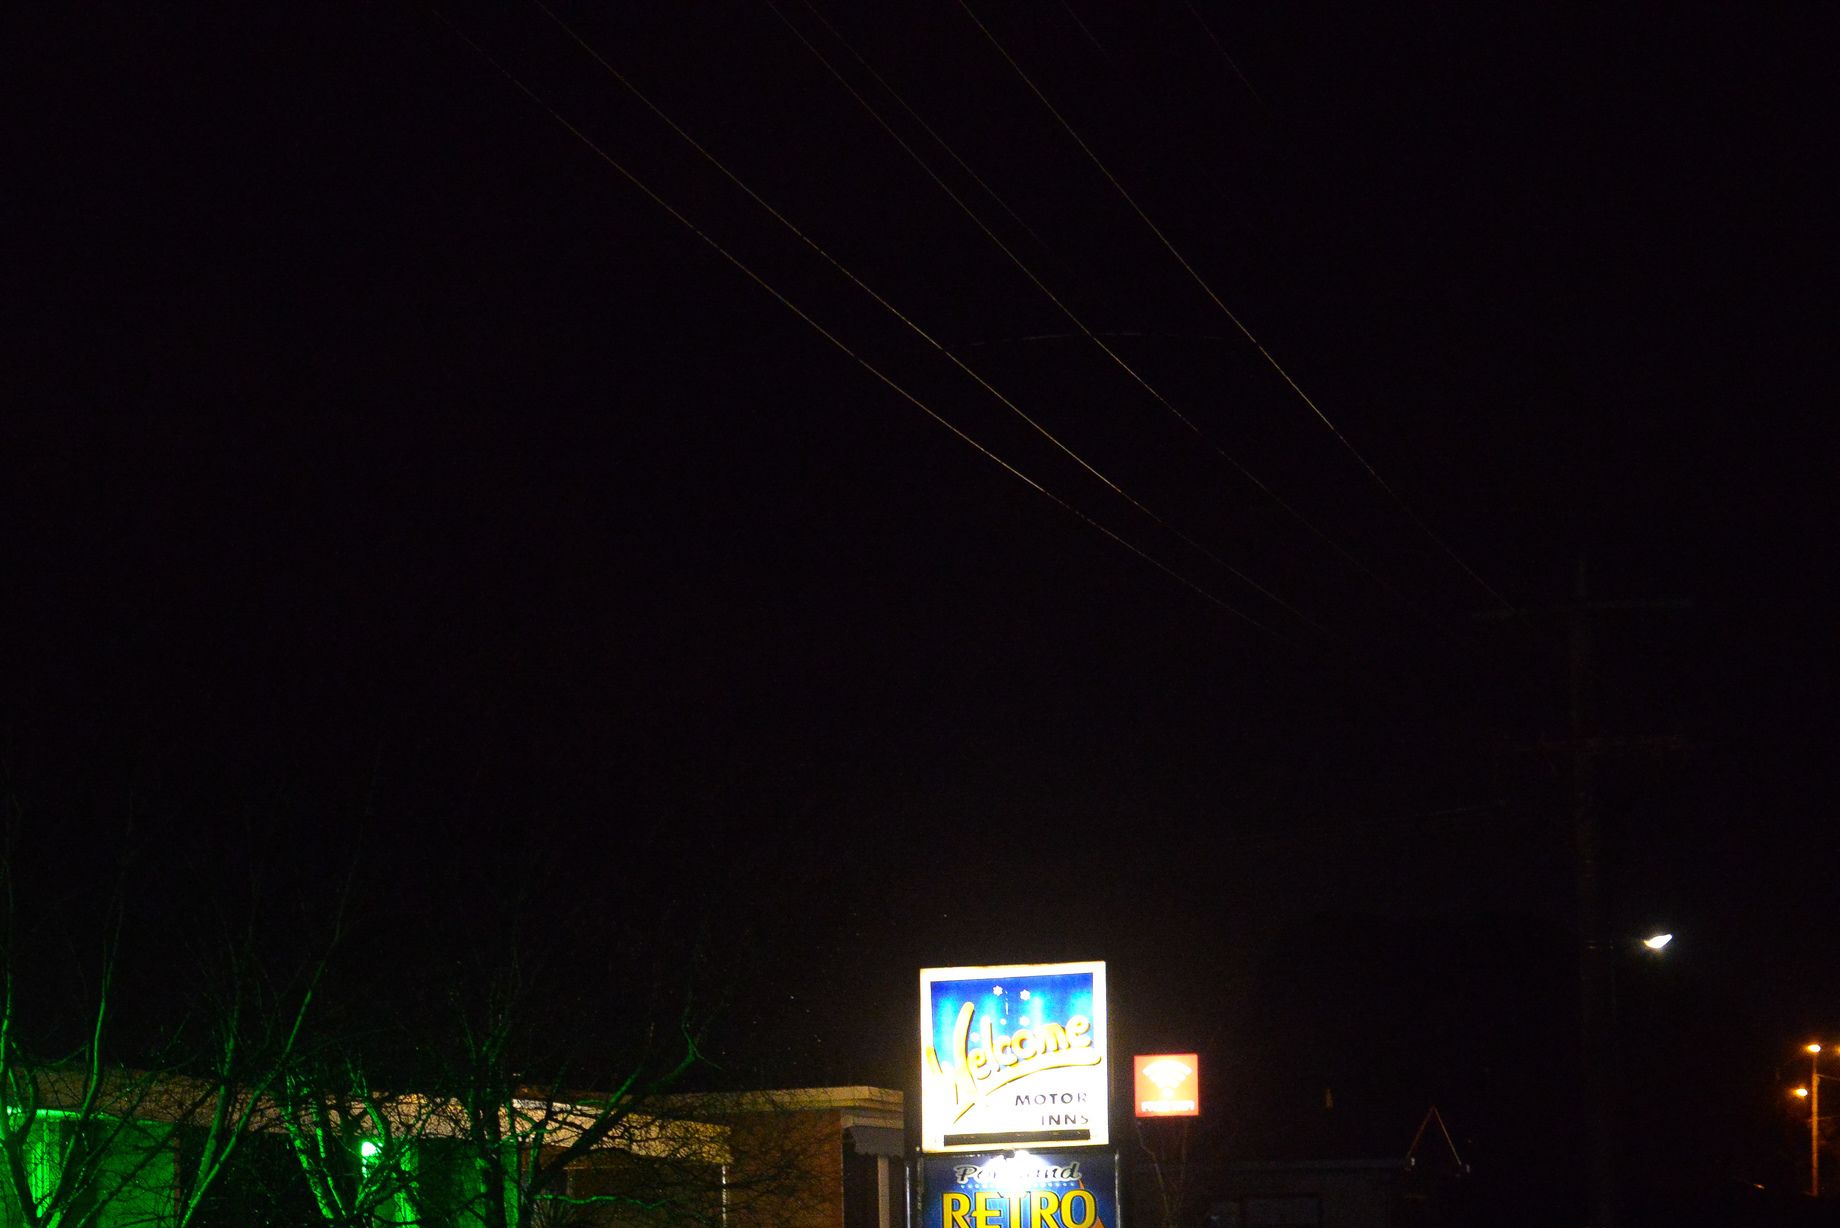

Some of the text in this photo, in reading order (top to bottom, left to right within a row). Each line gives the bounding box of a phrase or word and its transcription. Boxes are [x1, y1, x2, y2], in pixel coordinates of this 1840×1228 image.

[926, 1001, 1094, 1106] Welcome
[1015, 1092, 1088, 1107] MOTOR
[1041, 1114, 1089, 1126] INNS
